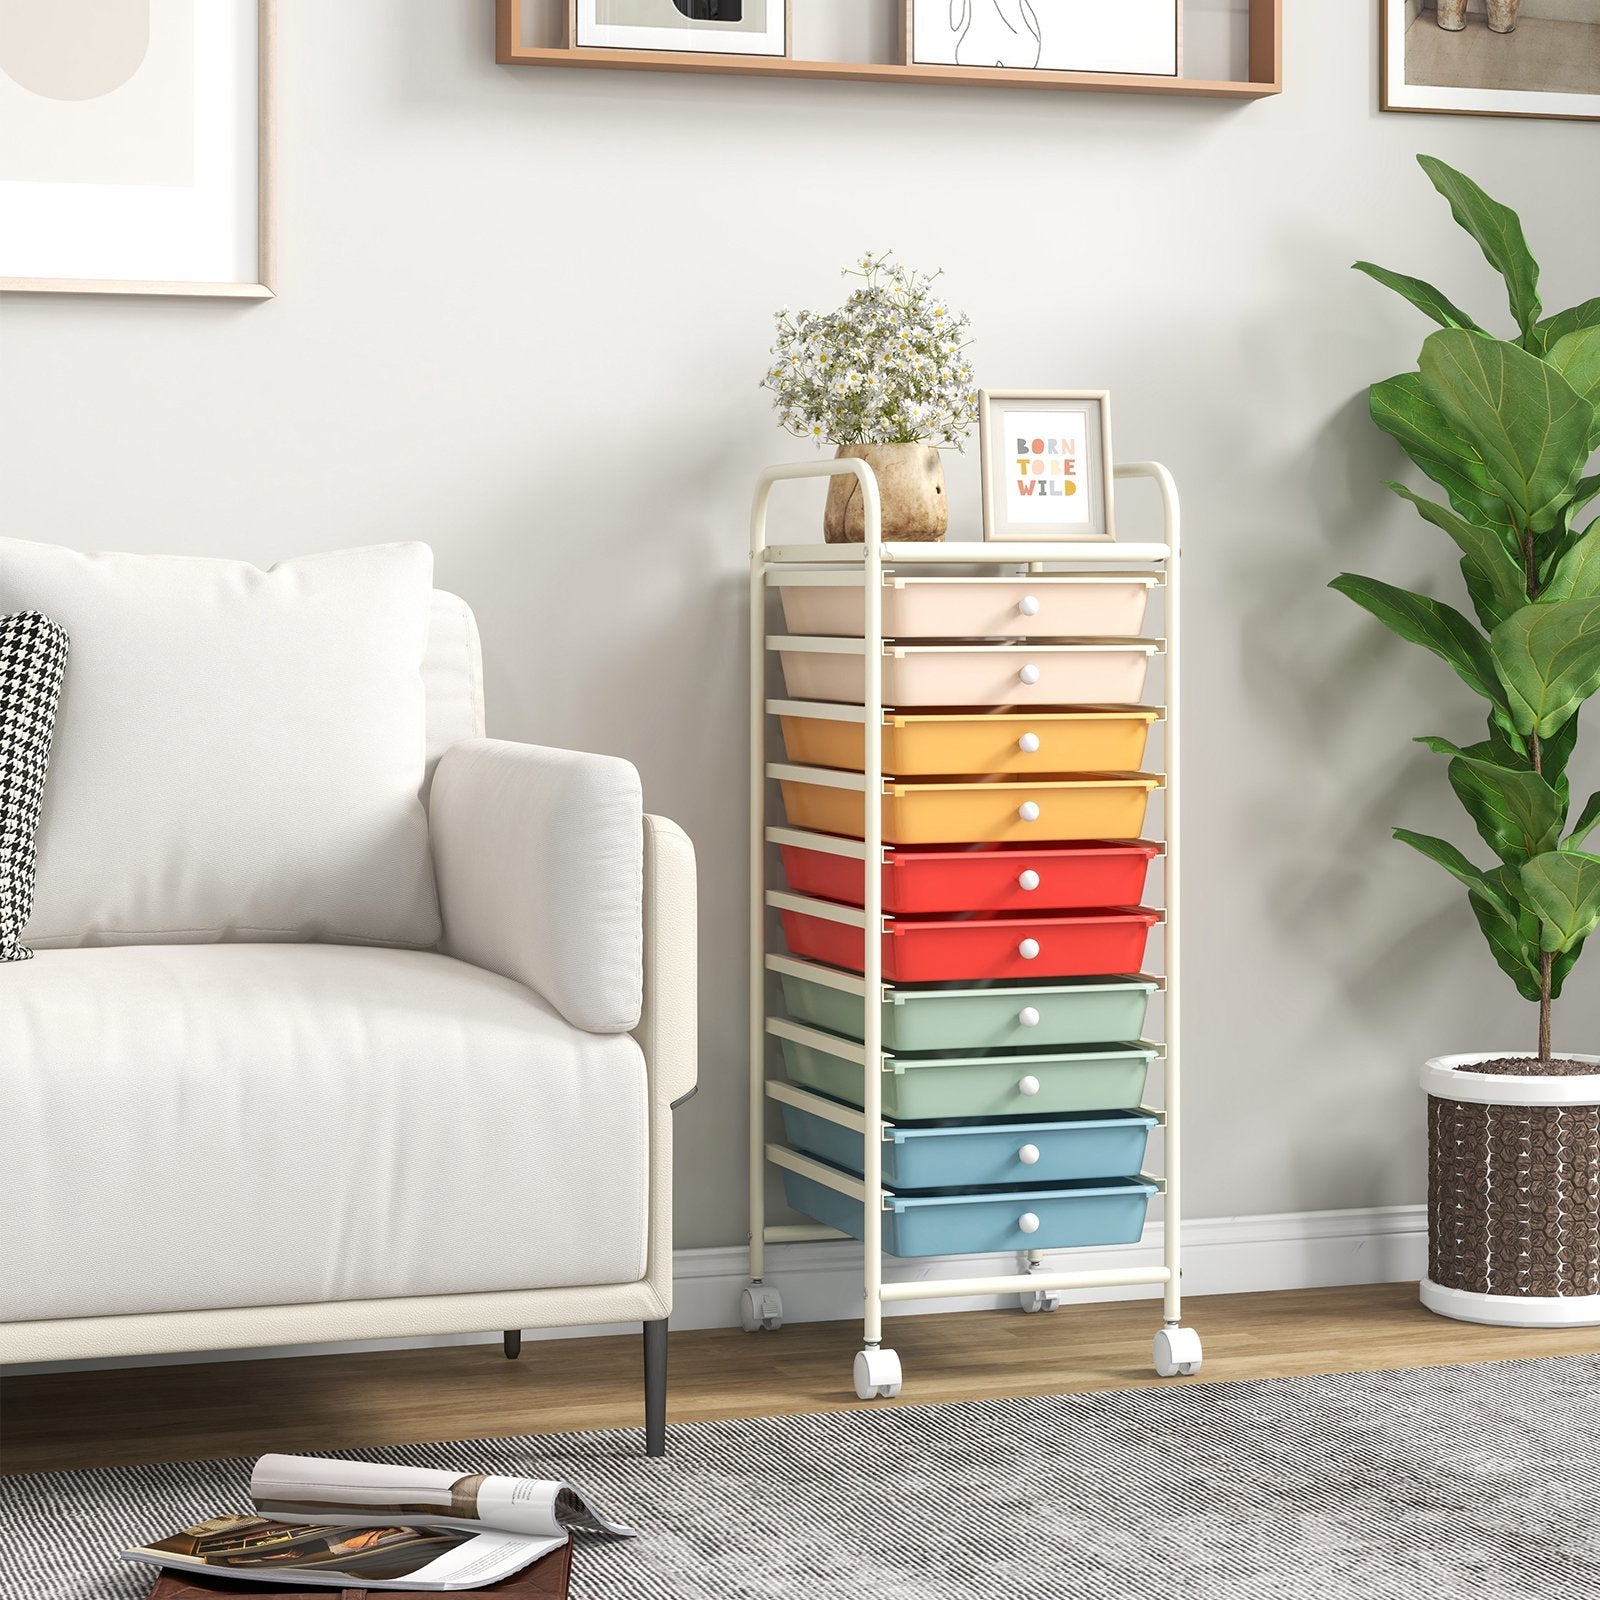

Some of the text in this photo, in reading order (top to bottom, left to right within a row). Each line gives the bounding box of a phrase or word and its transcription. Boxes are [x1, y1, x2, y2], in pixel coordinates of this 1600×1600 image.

[1017, 438, 1075, 455] BORN
[1016, 459, 1076, 475] TO BE
[1017, 480, 1077, 496] WILD
